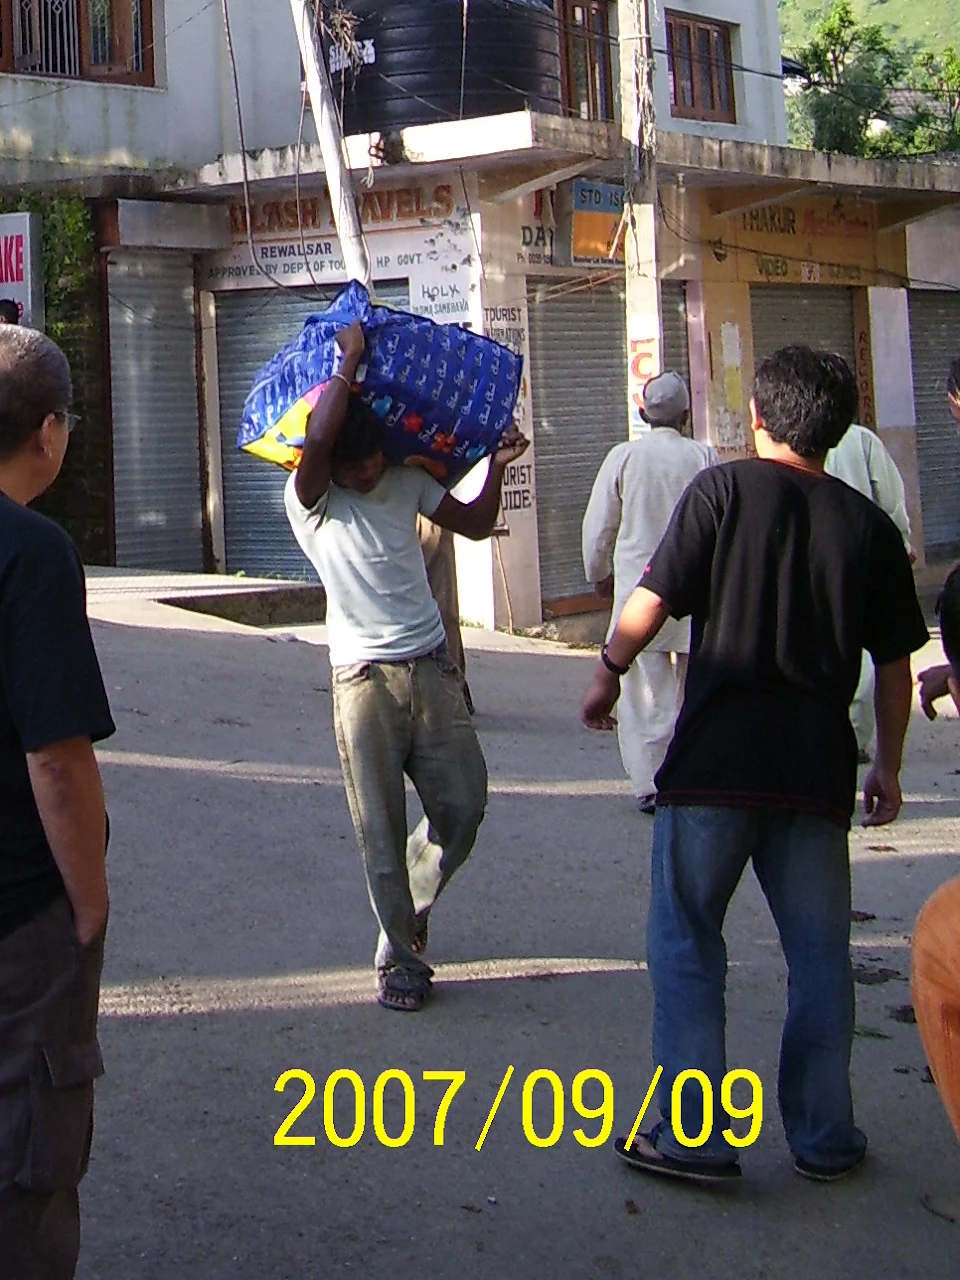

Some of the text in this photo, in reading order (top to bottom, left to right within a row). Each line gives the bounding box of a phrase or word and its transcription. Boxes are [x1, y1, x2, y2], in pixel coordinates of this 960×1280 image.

[324, 184, 456, 225] AVELS
[580, 188, 601, 204] STD
[260, 242, 332, 260] REWALSAR
[264, 264, 278, 277] BY
[313, 260, 326, 272] OF
[328, 259, 347, 272] TOU
[756, 255, 789, 277] VIDEO
[421, 284, 460, 300] HOLY
[483, 307, 522, 322] TOURIST
[503, 463, 533, 487] URIST
[501, 488, 533, 512] UIDE
